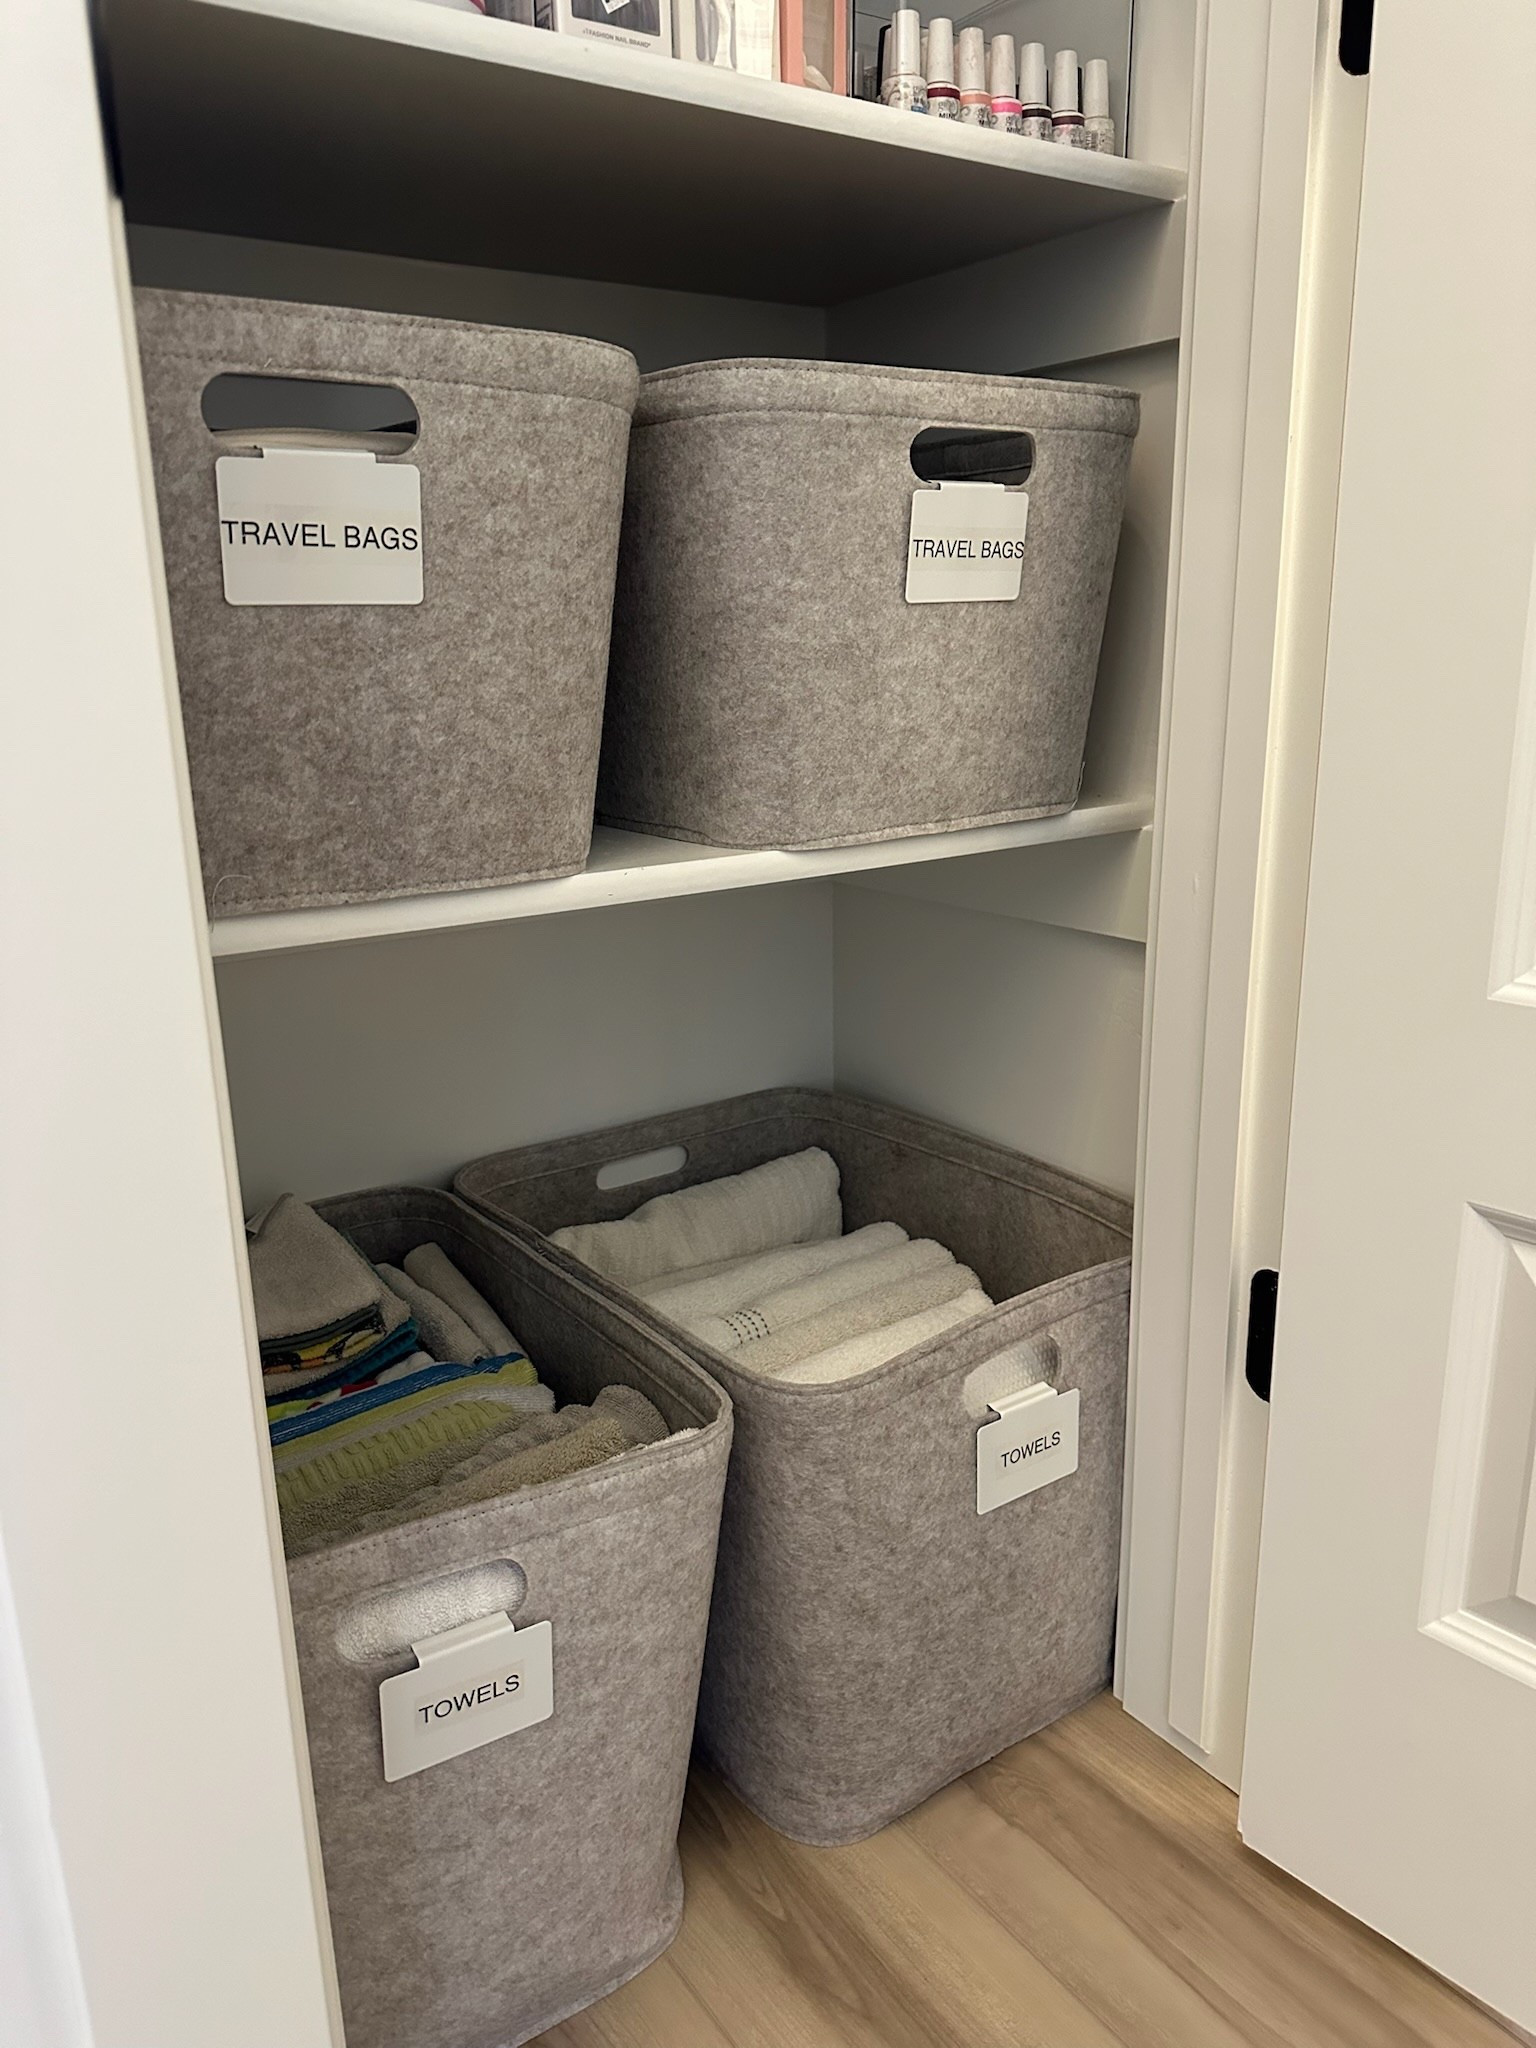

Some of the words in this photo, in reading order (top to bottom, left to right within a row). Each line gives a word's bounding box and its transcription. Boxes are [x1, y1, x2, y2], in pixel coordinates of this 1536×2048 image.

[589, 29, 614, 39] FASHION
[615, 35, 628, 44] NAIL
[221, 520, 336, 548] TRAVEL
[344, 525, 419, 551] BAGS
[913, 539, 976, 558] TRAVEL
[981, 541, 1025, 559] BAGS
[1000, 1431, 1061, 1467] TOWELS
[418, 1674, 520, 1723] TOWELS
